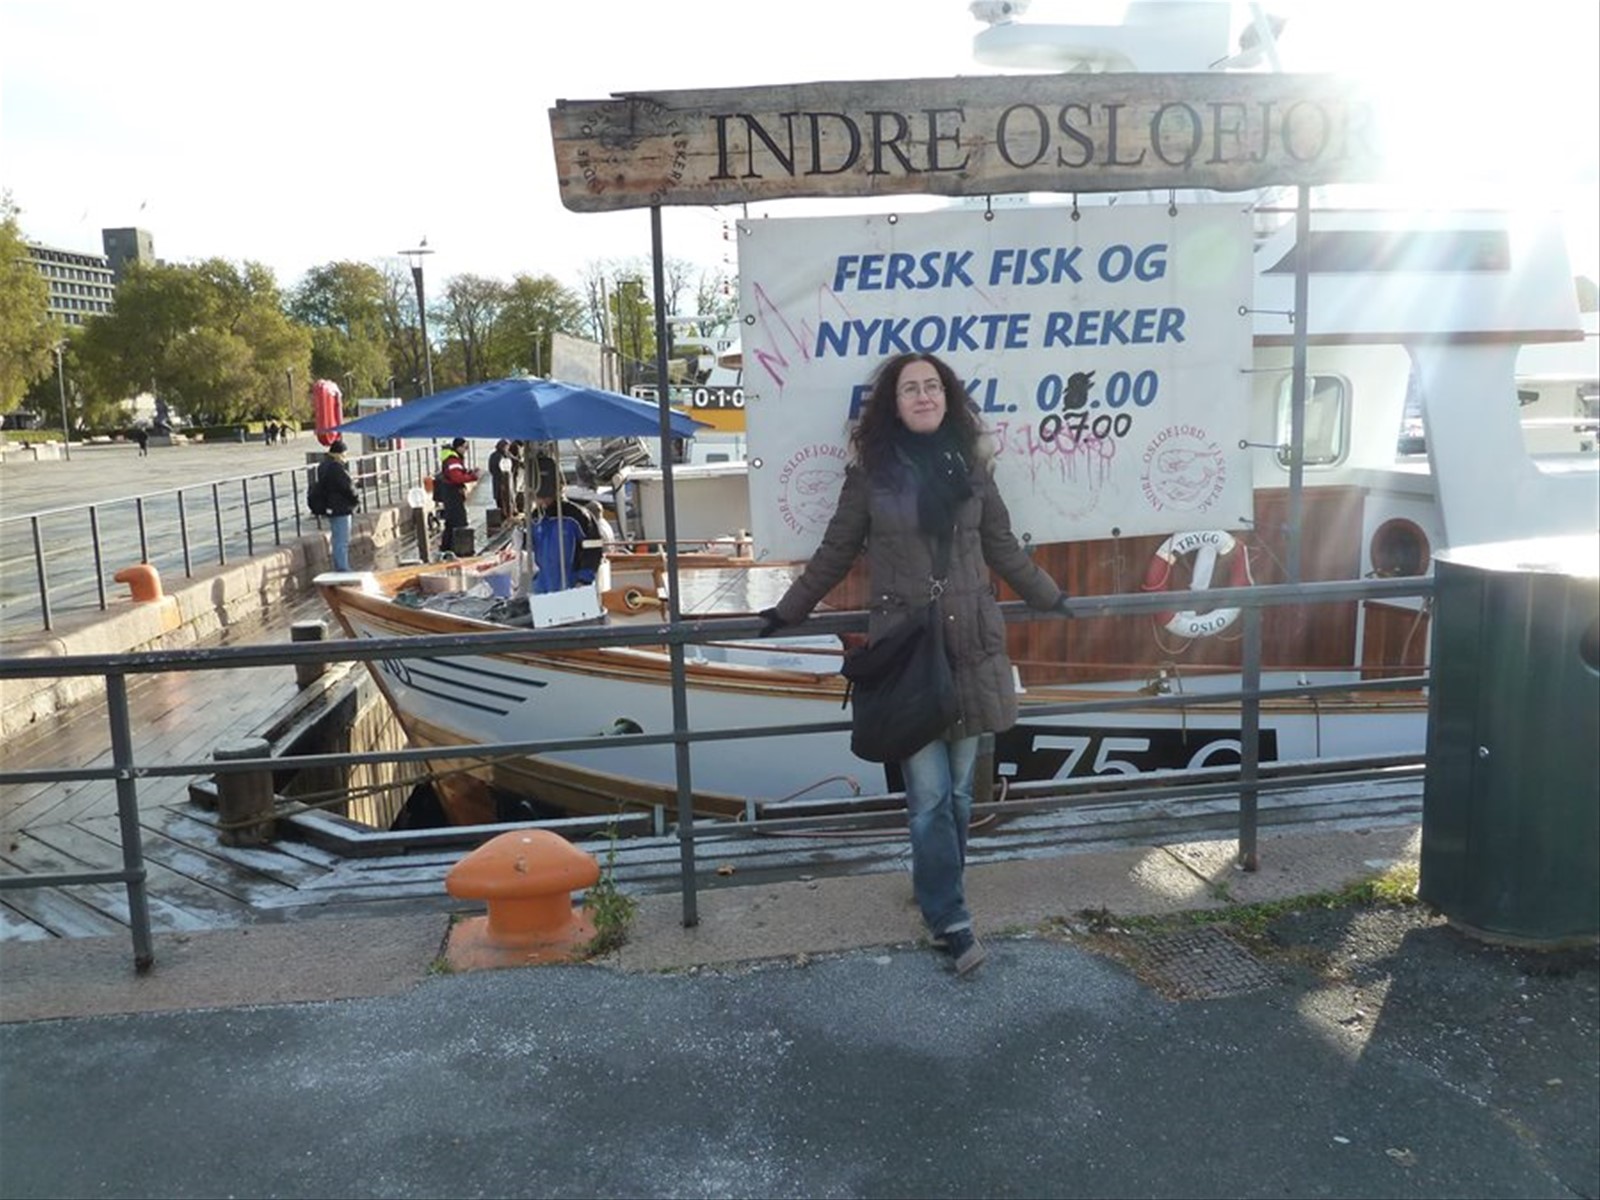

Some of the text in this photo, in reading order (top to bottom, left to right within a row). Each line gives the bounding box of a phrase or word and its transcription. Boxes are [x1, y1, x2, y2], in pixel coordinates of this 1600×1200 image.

[709, 108, 970, 180] INDRE
[833, 243, 1168, 292] FERSK FISK OG
[815, 313, 1030, 358] NYKOKTE
[1043, 307, 1186, 348] REKER
[1036, 370, 1158, 412] 0.00
[779, 444, 848, 484] OSLOFJORD
[1143, 425, 1206, 463] OSLOFJORD
[1176, 532, 1219, 551] TRYGG
[1190, 617, 1226, 633] OSLO
